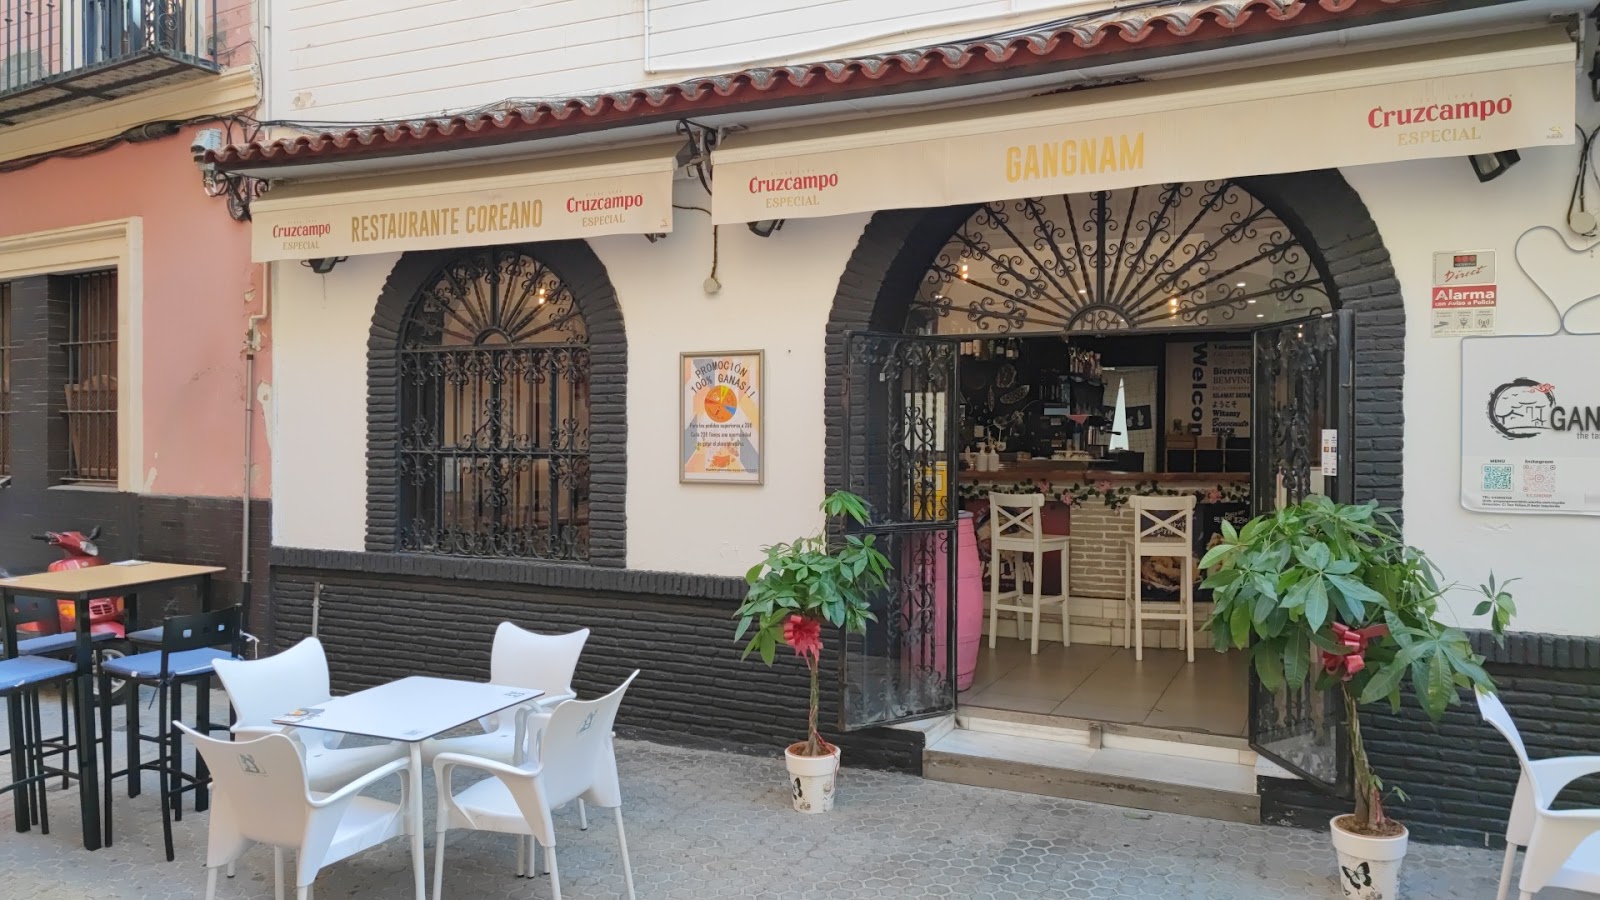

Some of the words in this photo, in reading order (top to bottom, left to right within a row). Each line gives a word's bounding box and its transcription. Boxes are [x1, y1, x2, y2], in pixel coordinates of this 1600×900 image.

[1368, 96, 1512, 129] Cruzcampo
[1397, 126, 1481, 146] ESPECIAL
[1006, 132, 1145, 184] GANGNAM
[749, 173, 838, 194] Cruzcampo
[566, 193, 644, 213] Cruzcampo
[766, 195, 820, 208] ESPECIAL
[272, 223, 331, 238] Cruzcampo
[351, 207, 459, 243] RESTAURANTE
[465, 198, 543, 233] COREANO
[582, 213, 626, 228] ESPECIAL
[282, 240, 320, 250] ESPECIAL
[1434, 289, 1495, 301] Alarma
[695, 360, 748, 379] PROMOCIÓN
[691, 375, 713, 394] 100%
[717, 373, 756, 399] GANAS!!
[1192, 342, 1208, 436] Welcom
[1577, 432, 1589, 440] the
